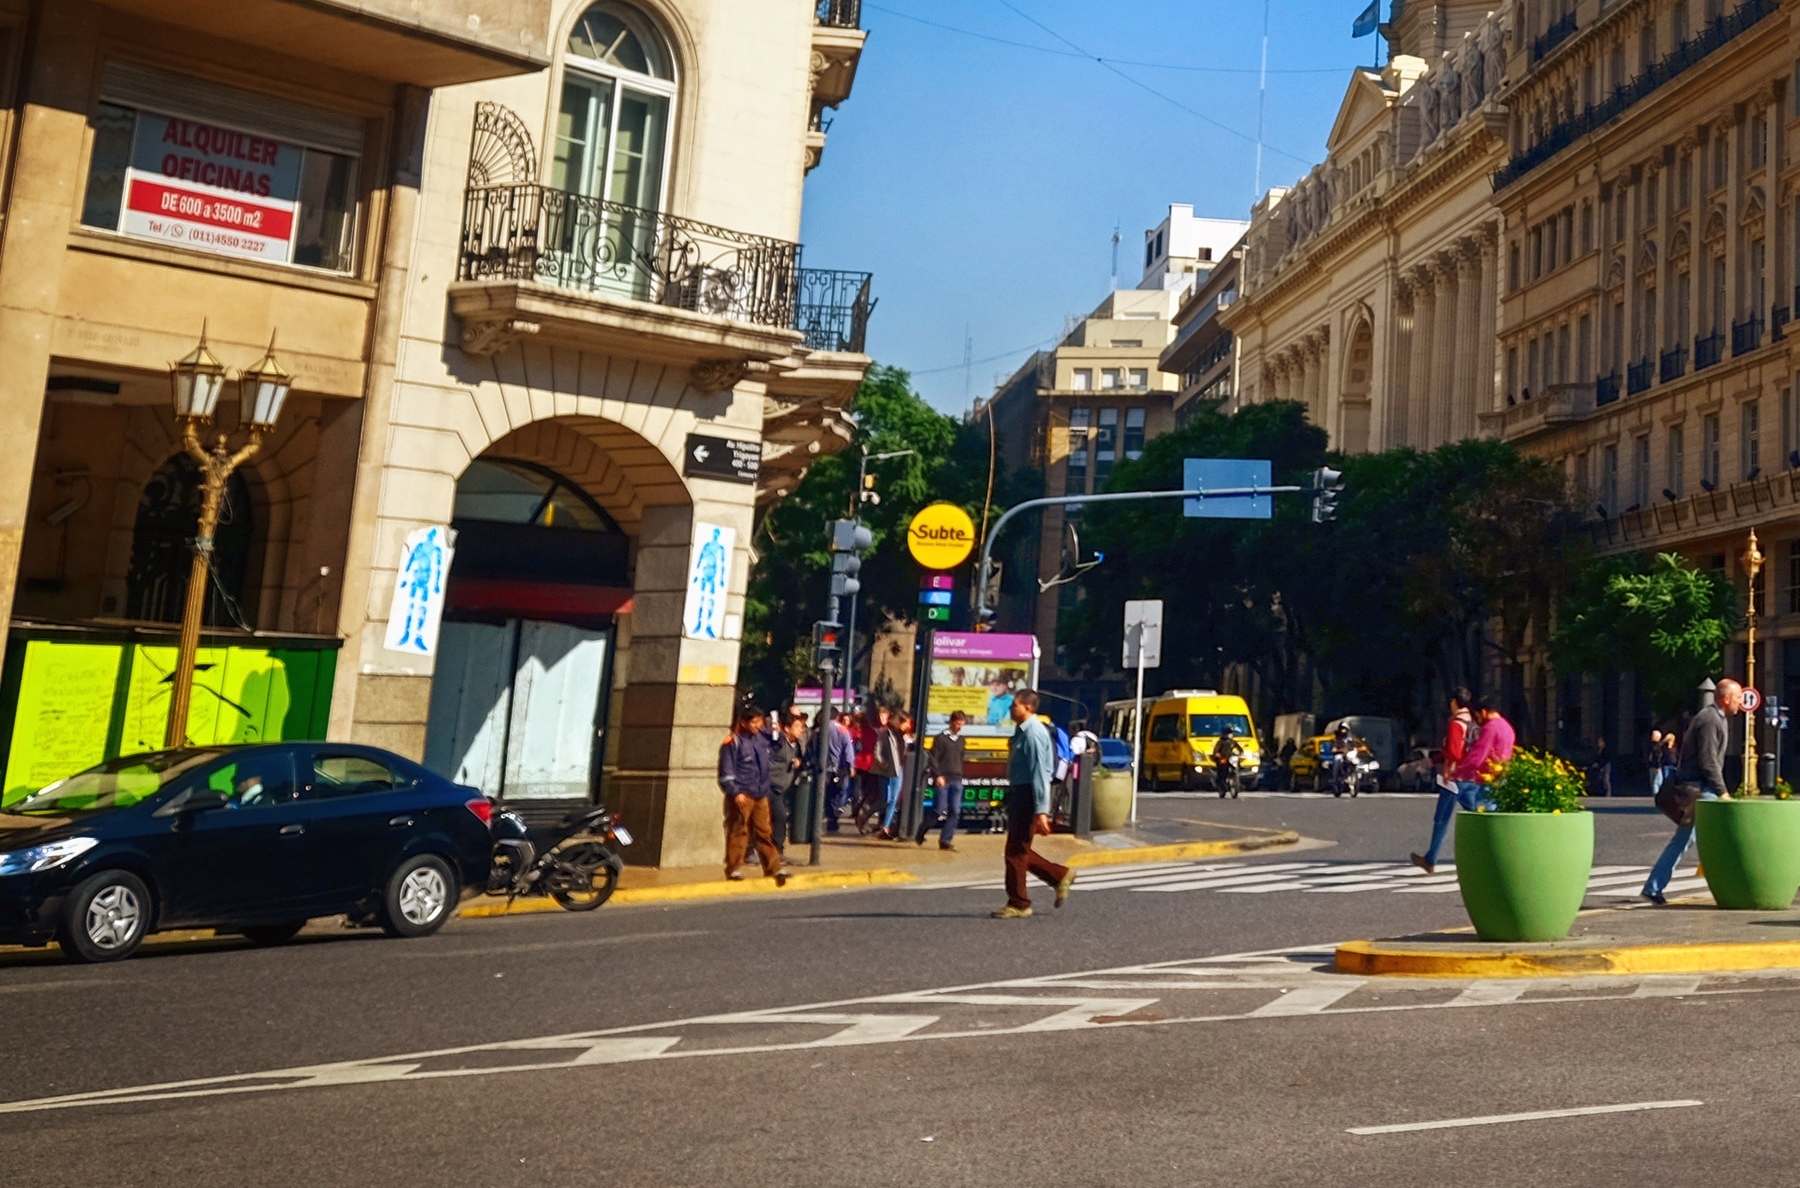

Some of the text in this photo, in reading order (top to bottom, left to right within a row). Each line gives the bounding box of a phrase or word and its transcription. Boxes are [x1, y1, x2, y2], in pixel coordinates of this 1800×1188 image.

[162, 118, 279, 166] ALQUILER
[161, 153, 271, 197] OFICINAS
[161, 192, 263, 228] DE 600 a 3500 m2
[149, 220, 162, 233] Tel
[241, 239, 265, 252] 2227
[917, 524, 966, 541] Subte
